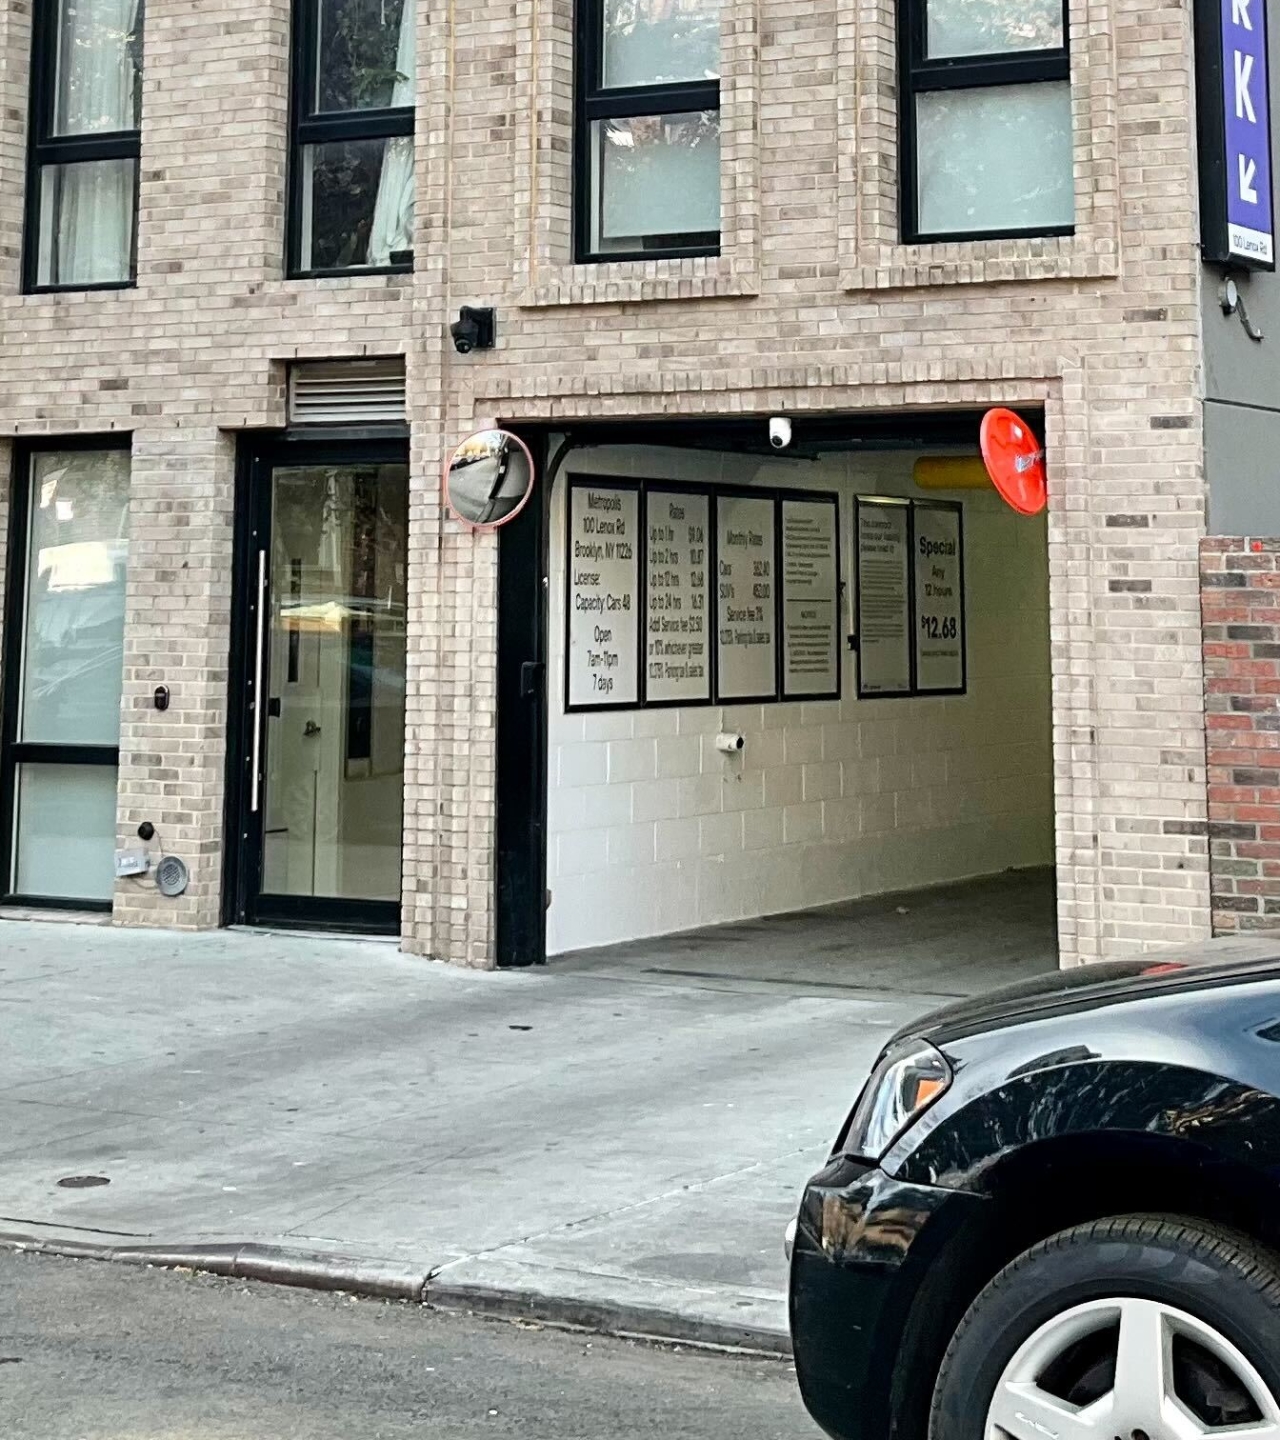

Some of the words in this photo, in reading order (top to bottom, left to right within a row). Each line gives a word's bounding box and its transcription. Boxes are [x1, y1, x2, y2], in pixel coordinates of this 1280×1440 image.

[588, 492, 622, 513] Metropolis
[583, 517, 595, 534] 100
[596, 517, 615, 535] Lenox
[616, 518, 625, 535] Rd
[650, 525, 657, 544] Up
[658, 526, 664, 541] to
[575, 541, 604, 562] Brooklyn,
[605, 542, 615, 559] NY
[616, 542, 632, 560] 11226
[920, 536, 956, 558] Special
[650, 548, 657, 566] Up
[658, 549, 665, 564] to
[650, 570, 657, 589] Up
[658, 571, 664, 587] to
[932, 565, 946, 579] Any
[925, 584, 933, 597] 12
[933, 584, 953, 597] hours
[607, 593, 621, 610] Cars
[623, 594, 631, 610] 48
[650, 594, 657, 610] Up
[658, 594, 664, 610] to
[594, 625, 612, 646] Open
[921, 615, 957, 639] $12.68
[587, 650, 619, 670] 7am-11pm
[593, 674, 597, 690] 7
[598, 674, 613, 694] days
